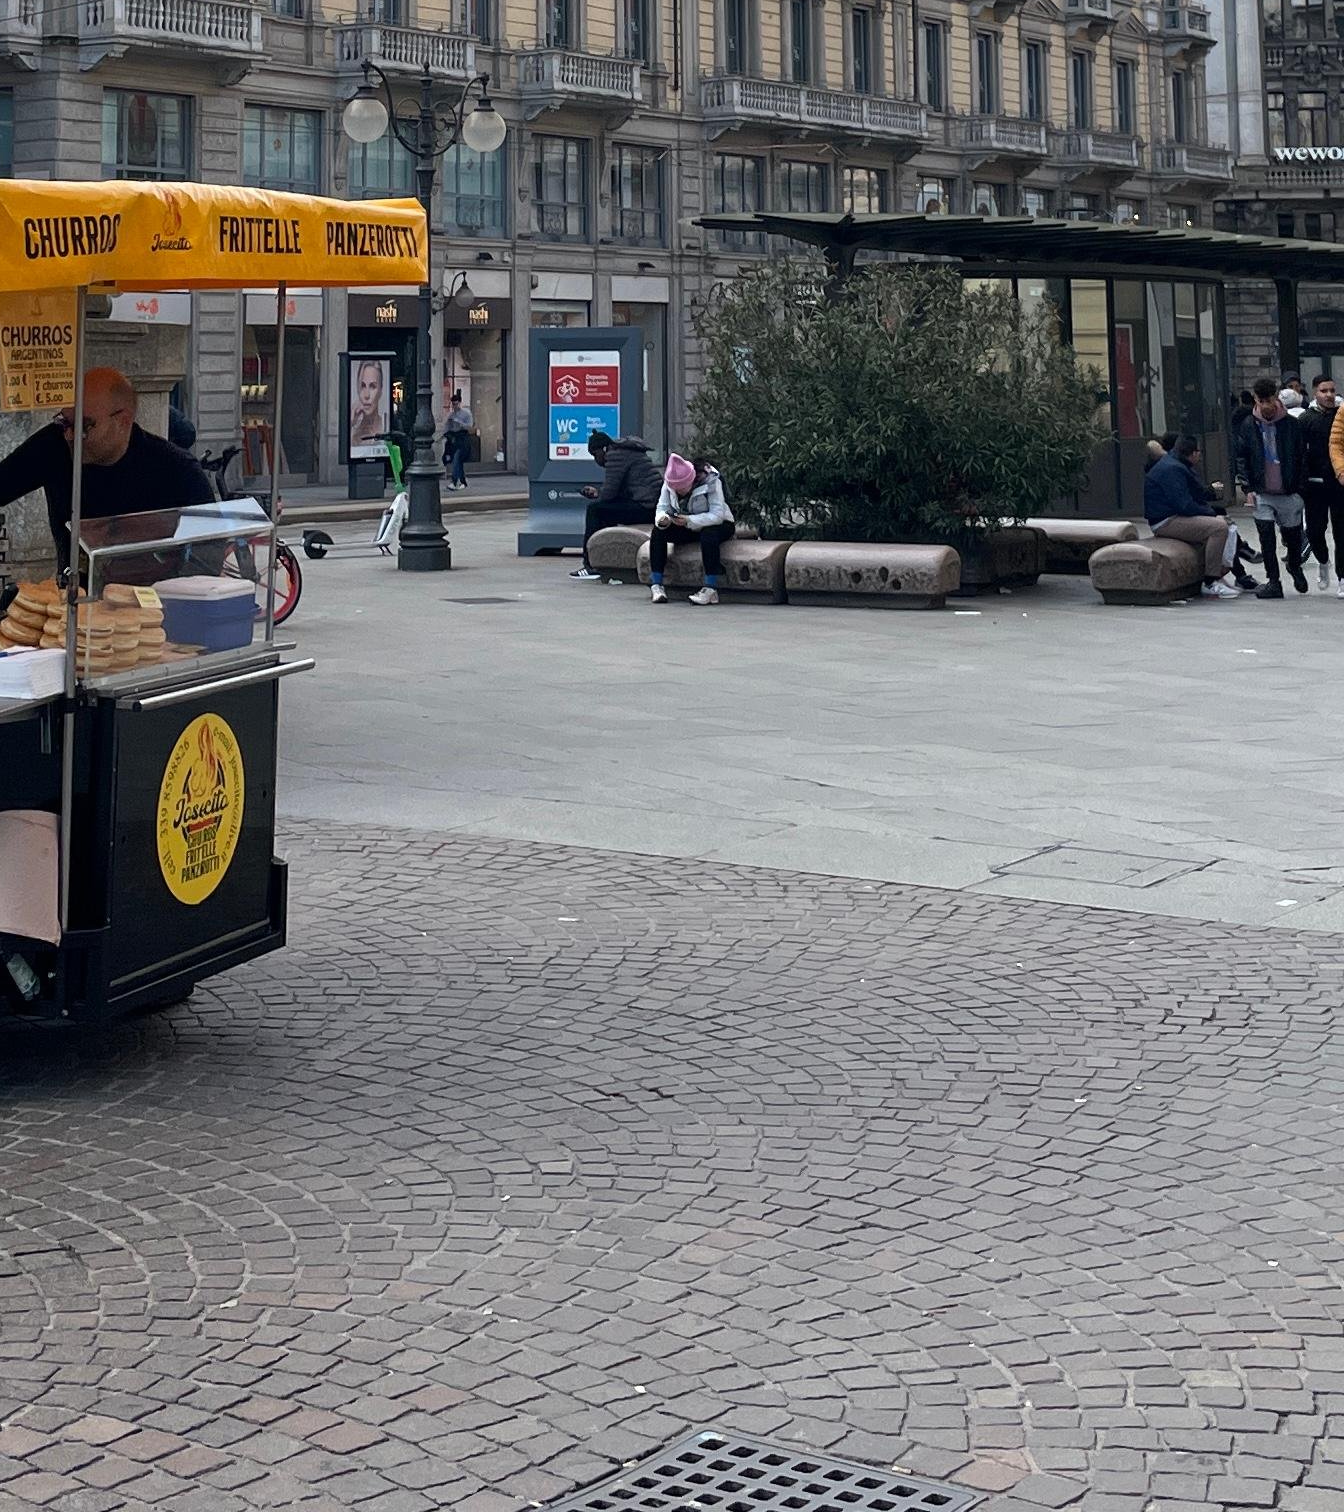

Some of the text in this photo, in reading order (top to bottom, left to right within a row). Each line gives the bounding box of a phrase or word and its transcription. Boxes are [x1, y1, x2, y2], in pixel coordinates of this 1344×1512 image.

[24, 214, 121, 259] CHURROS
[219, 215, 302, 255] FRITTELLE
[326, 221, 419, 258] PANZEROTTI
[376, 304, 397, 317] nashi
[469, 306, 489, 319] nashi
[1, 325, 73, 347] CHURROS
[10, 348, 64, 360] ARGENTINOS
[42, 381, 74, 391] churros
[556, 419, 579, 433] WC
[173, 789, 230, 829] Josecito
